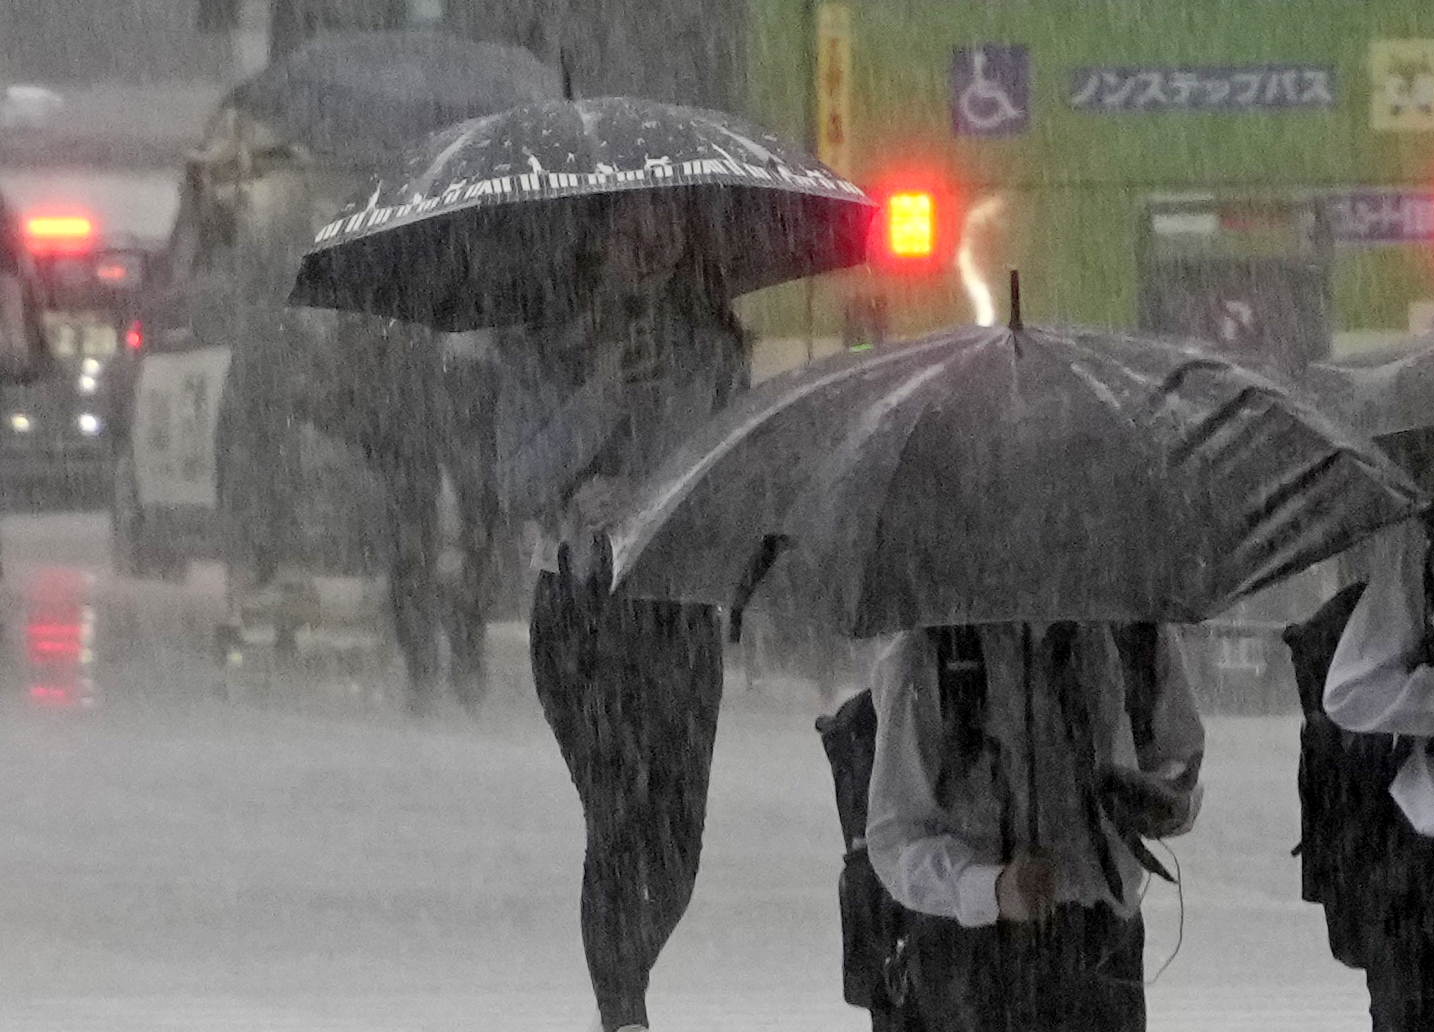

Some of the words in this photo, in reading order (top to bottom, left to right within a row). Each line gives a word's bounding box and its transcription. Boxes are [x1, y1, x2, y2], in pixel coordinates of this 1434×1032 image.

[1071, 69, 1334, 106] ノンステップバス
